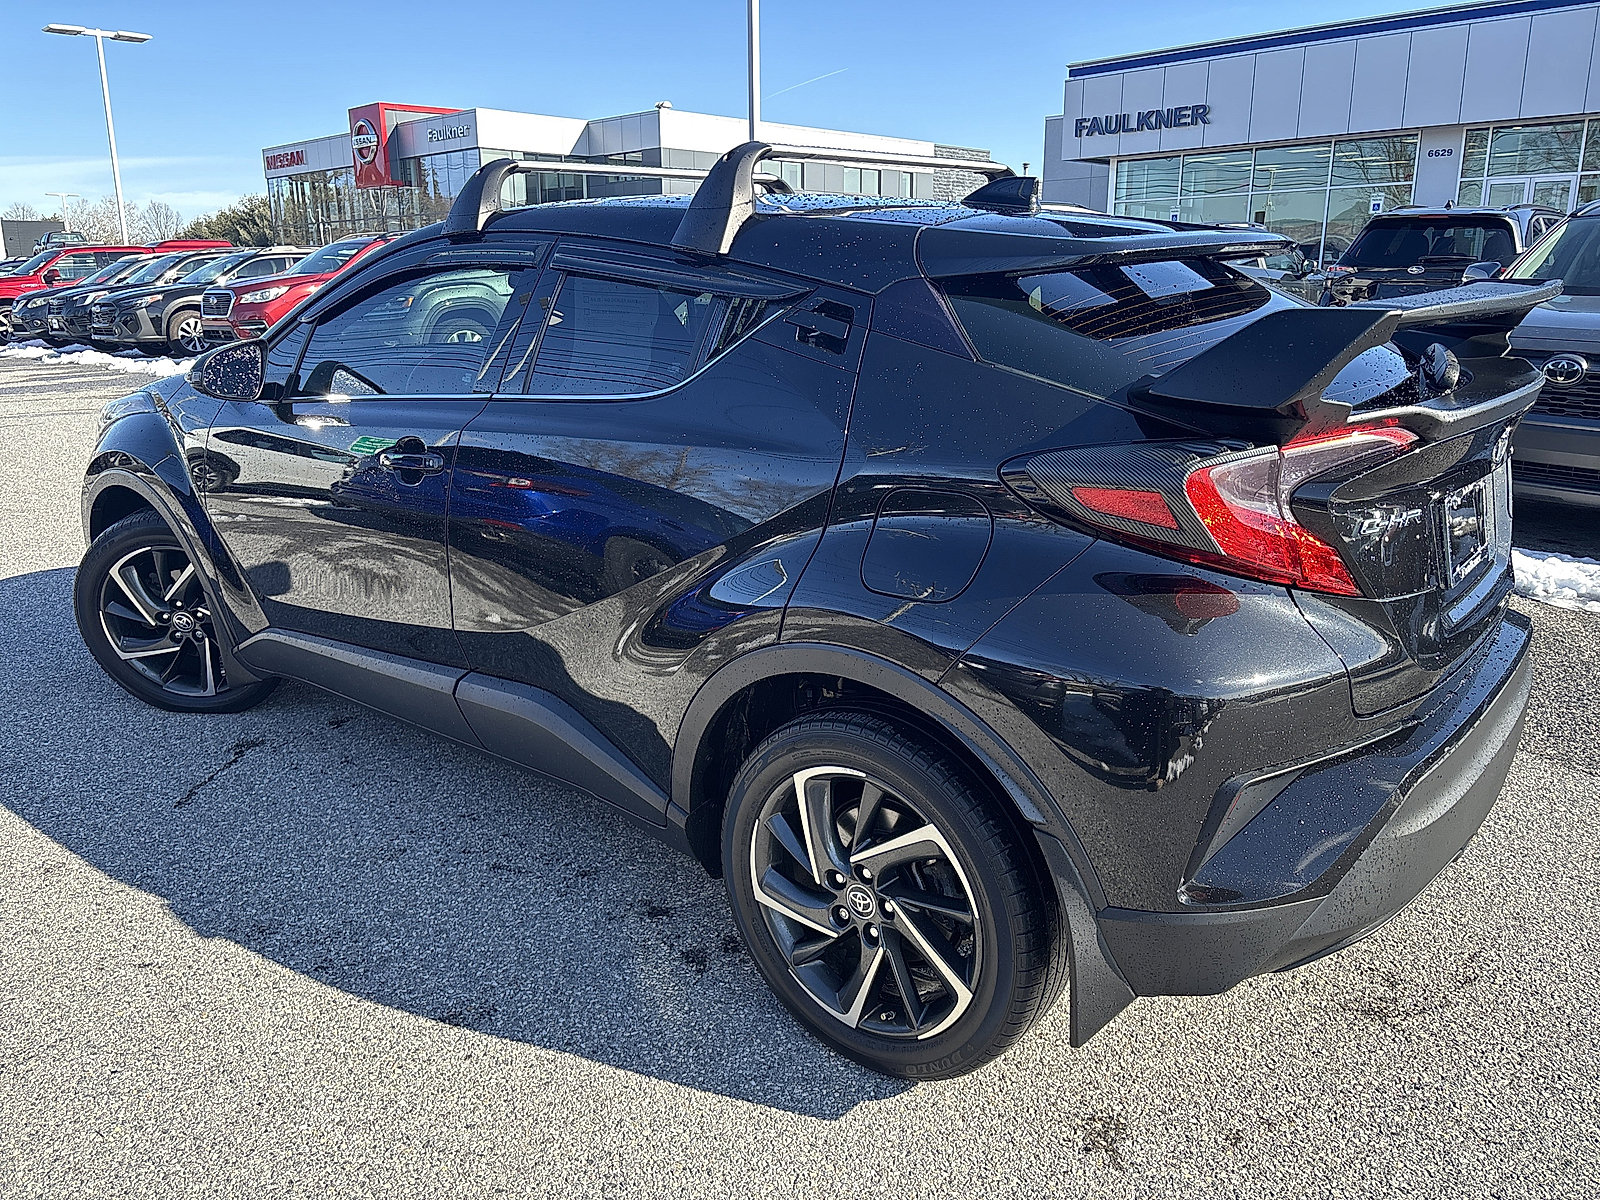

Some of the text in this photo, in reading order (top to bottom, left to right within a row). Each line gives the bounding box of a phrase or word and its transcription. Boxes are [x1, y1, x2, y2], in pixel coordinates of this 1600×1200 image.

[1074, 104, 1210, 138] FAULKNER
[427, 124, 470, 142] Faulkner
[266, 149, 305, 170] NISSAN
[1428, 148, 1453, 157] 6629
